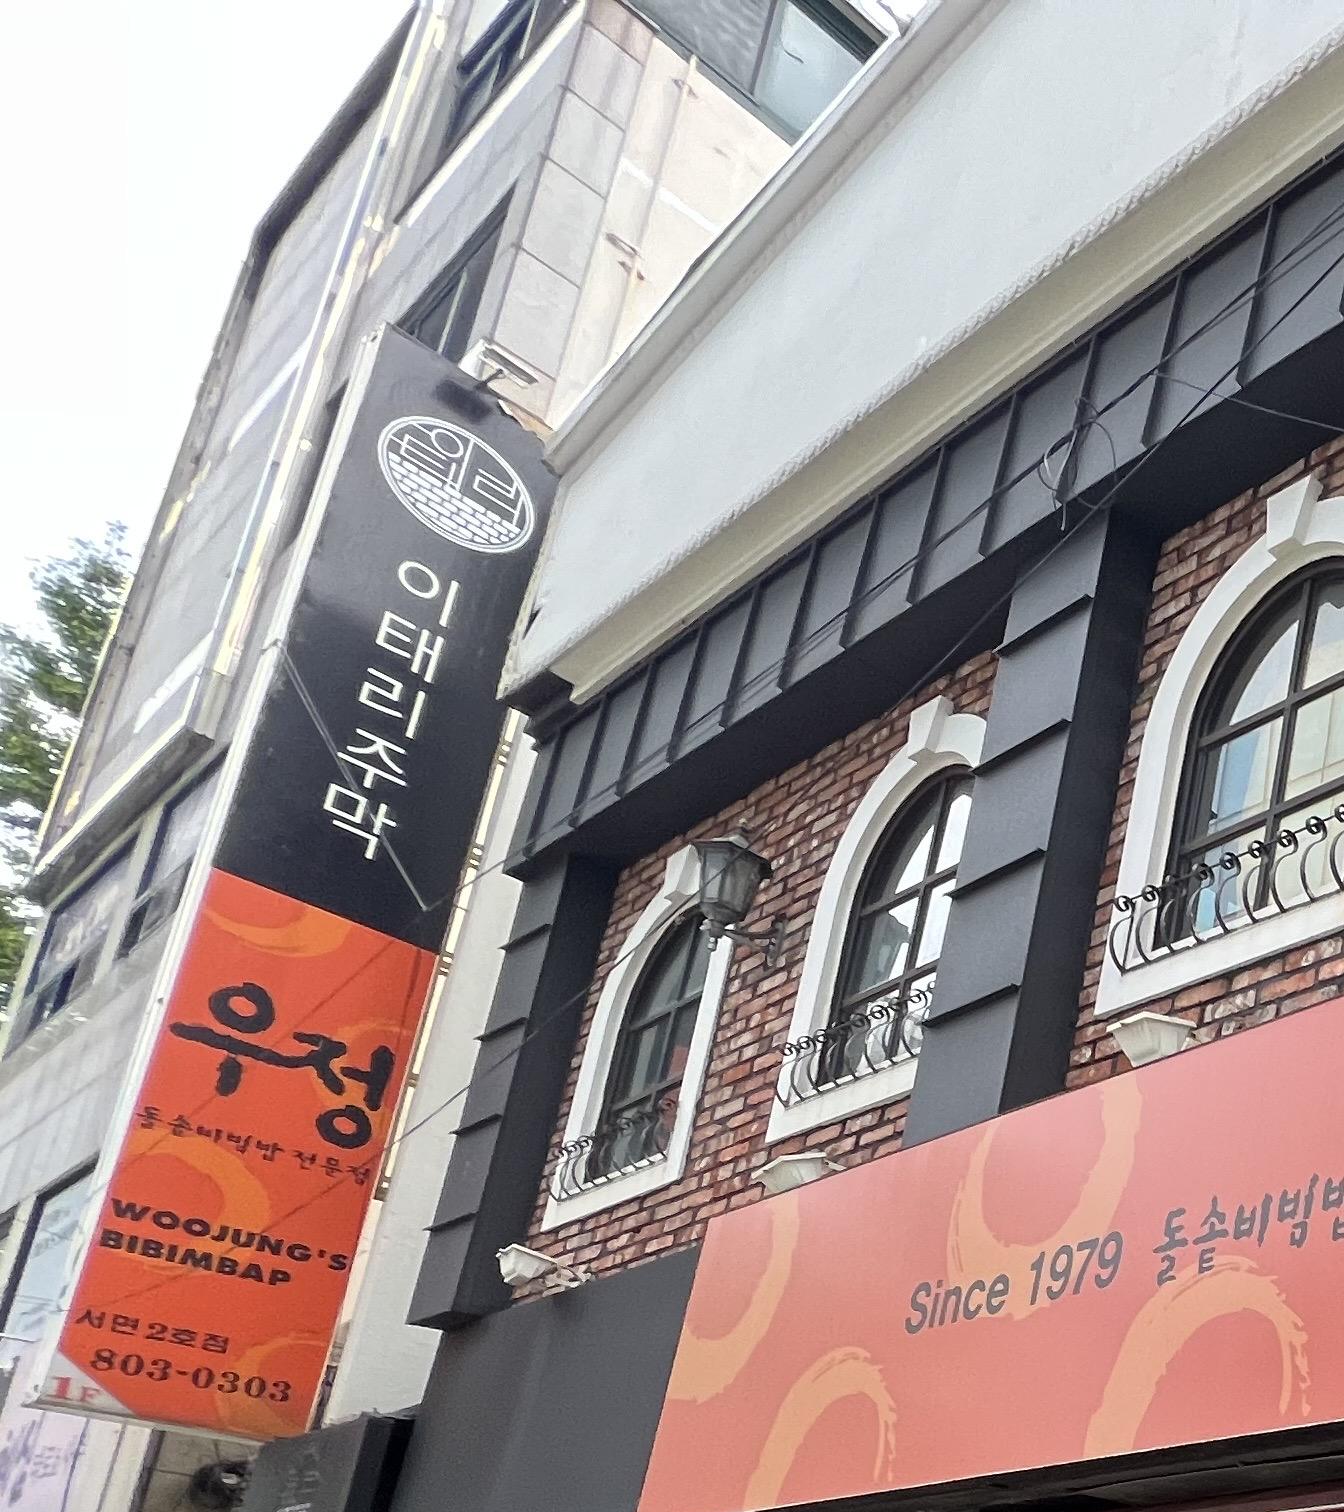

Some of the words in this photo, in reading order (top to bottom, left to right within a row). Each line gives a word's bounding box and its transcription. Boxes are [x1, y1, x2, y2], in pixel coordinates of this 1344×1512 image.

[322, 560, 460, 861] 이태리주막
[170, 981, 395, 1149] 우정
[136, 1106, 285, 1161] 돌솥비빔밥
[293, 1149, 371, 1185] 전문점
[100, 1228, 292, 1285] BIBIMBAP
[111, 1198, 350, 1271] WOOJUNG'S
[904, 1273, 1010, 1335] Since
[1029, 1231, 1124, 1306] 1979
[76, 1308, 140, 1336] 서면
[145, 1322, 230, 1354] 2호점
[90, 1347, 293, 1402] 803-0303
